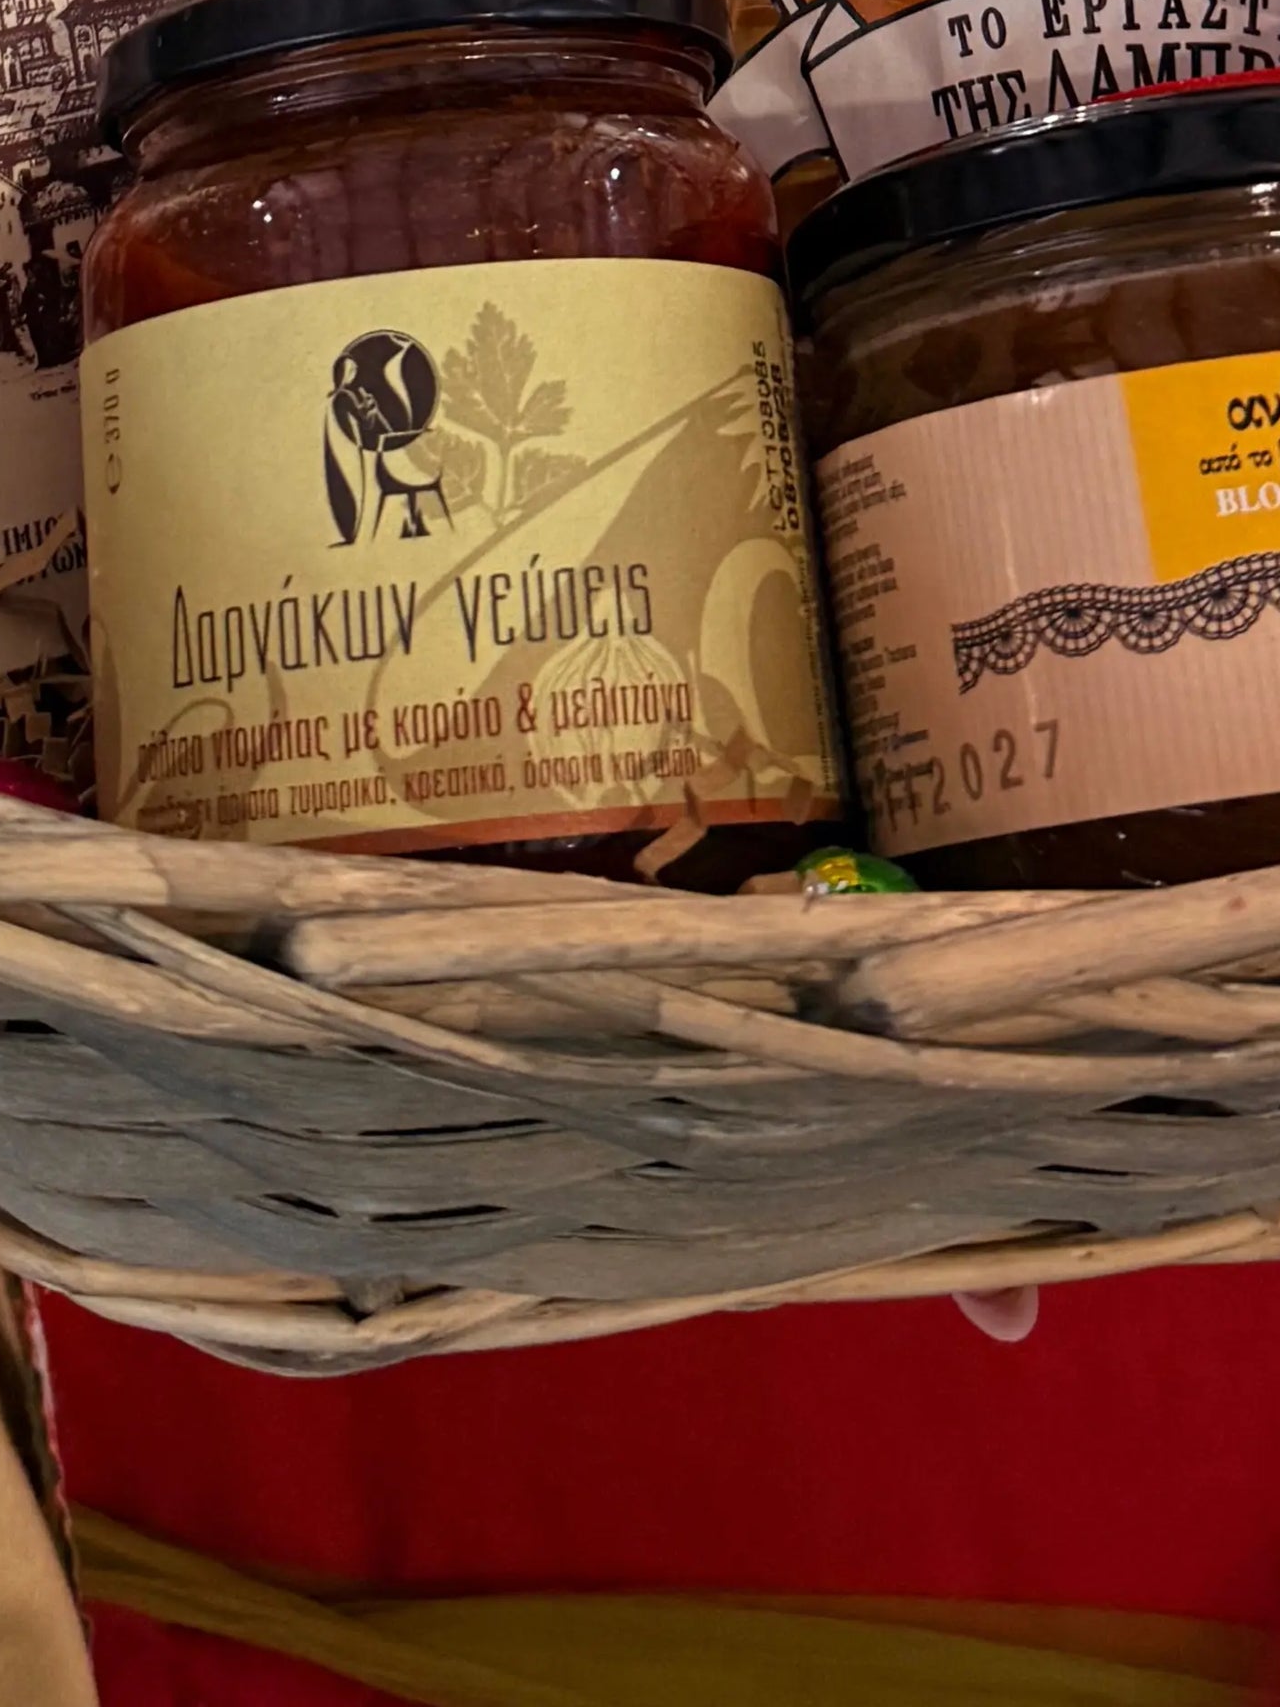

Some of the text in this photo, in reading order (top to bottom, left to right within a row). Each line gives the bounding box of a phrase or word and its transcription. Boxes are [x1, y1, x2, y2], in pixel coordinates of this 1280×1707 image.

[947, 5, 1008, 57] ΤΟ
[931, 68, 1031, 138] ΤΗΣ
[1199, 441, 1242, 475] από
[1248, 448, 1273, 467] το
[172, 553, 653, 694] Δαρνάκων γεύσεις
[342, 708, 380, 759] με
[392, 686, 503, 749] καρότο
[516, 681, 538, 734] &
